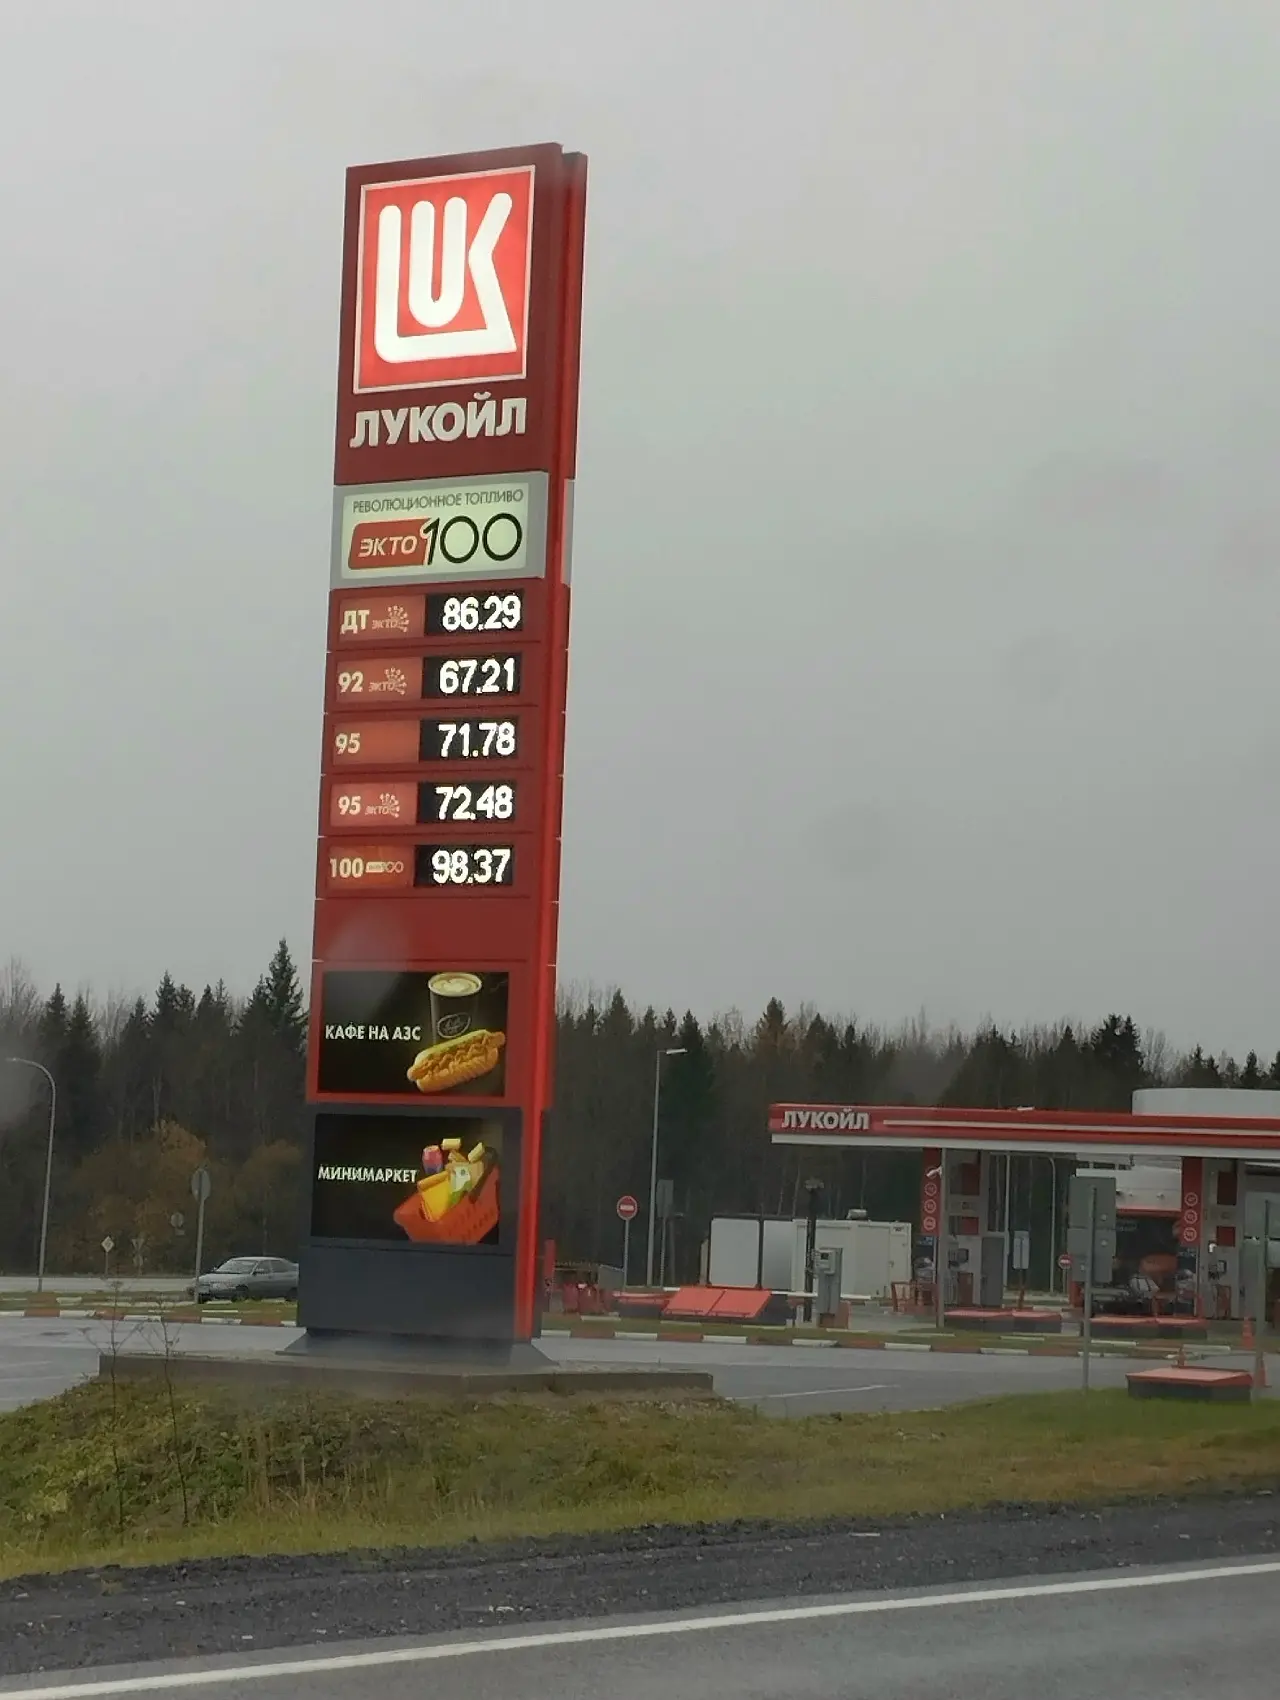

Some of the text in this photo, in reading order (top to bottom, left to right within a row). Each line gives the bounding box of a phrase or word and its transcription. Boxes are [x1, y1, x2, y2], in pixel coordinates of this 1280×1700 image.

[350, 391, 527, 448] ЛУКОЙЛ
[353, 488, 524, 513] РЕВОЛЮЦИОННОЕ ТОПЛИВО
[358, 512, 523, 565] ЭКТО 100
[340, 609, 370, 634] ДТ
[442, 595, 521, 631] 86.29
[338, 671, 364, 693] 92
[439, 657, 515, 694] 67.21
[335, 721, 516, 758] 95 71.78
[338, 795, 361, 816] 95
[435, 785, 514, 821] 72.48
[329, 857, 364, 879] 100
[431, 848, 511, 884] 98.37
[325, 1022, 366, 1040] КАФЕ
[368, 1024, 389, 1040] НА
[391, 1026, 422, 1041] АЗС
[781, 1108, 870, 1130] ЛУКОЙЛ
[317, 1164, 419, 1184] МИНИМАРКЕТ
